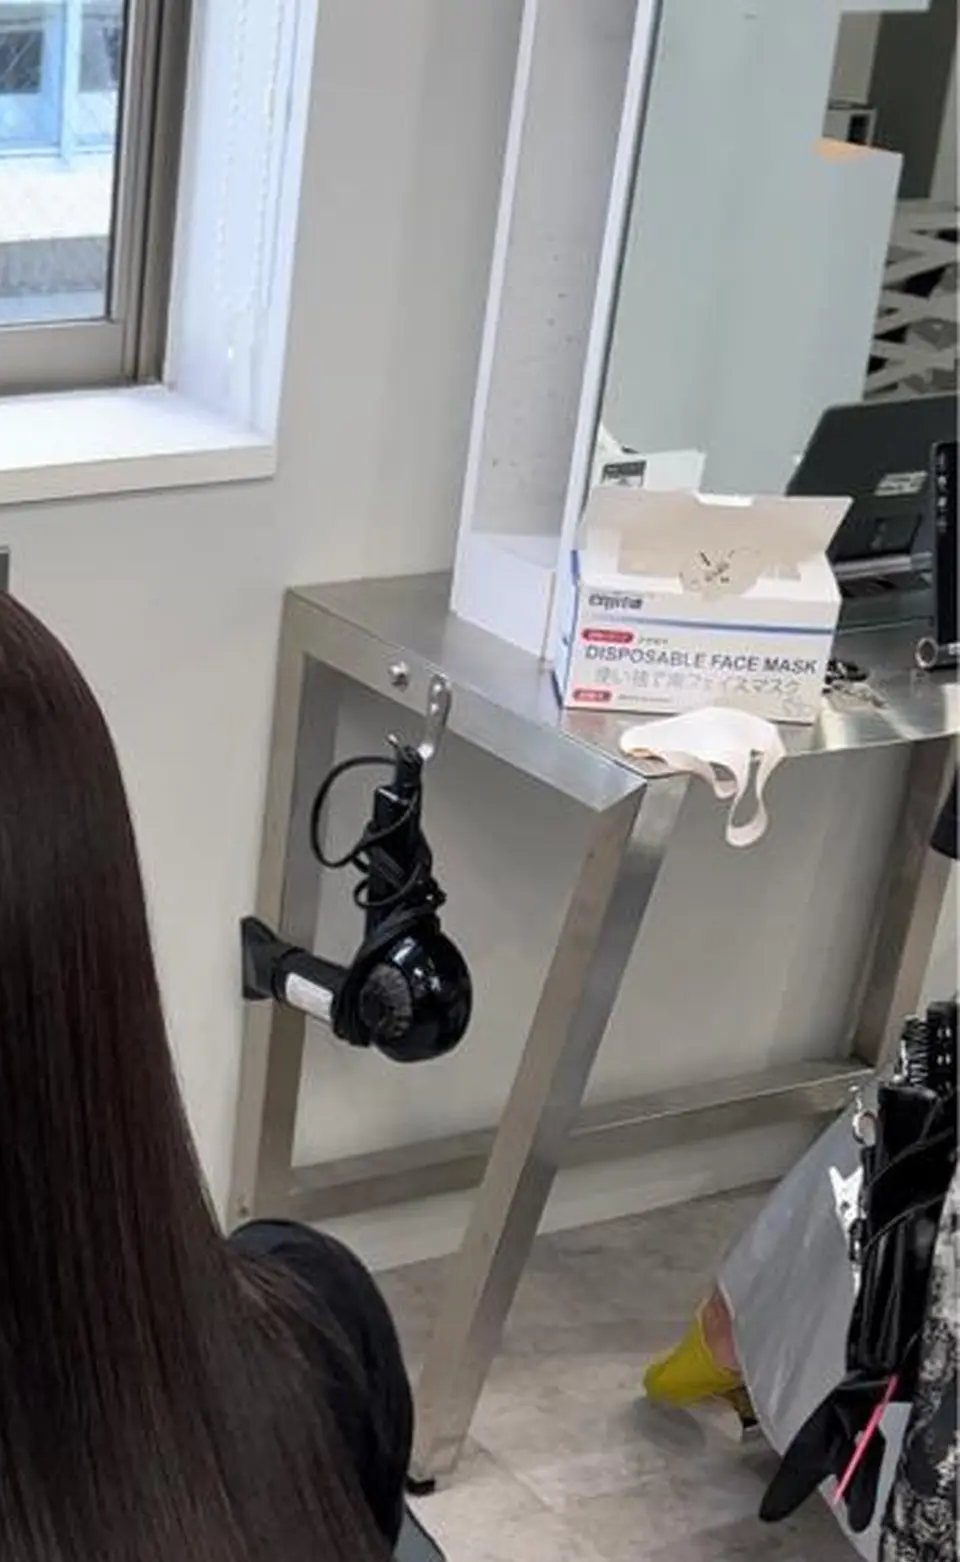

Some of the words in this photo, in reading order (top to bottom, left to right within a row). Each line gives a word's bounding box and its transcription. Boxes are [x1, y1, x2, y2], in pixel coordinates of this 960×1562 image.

[585, 644, 707, 669] DISPOSABLE
[711, 653, 760, 672] FACE
[762, 656, 817, 674] MASK
